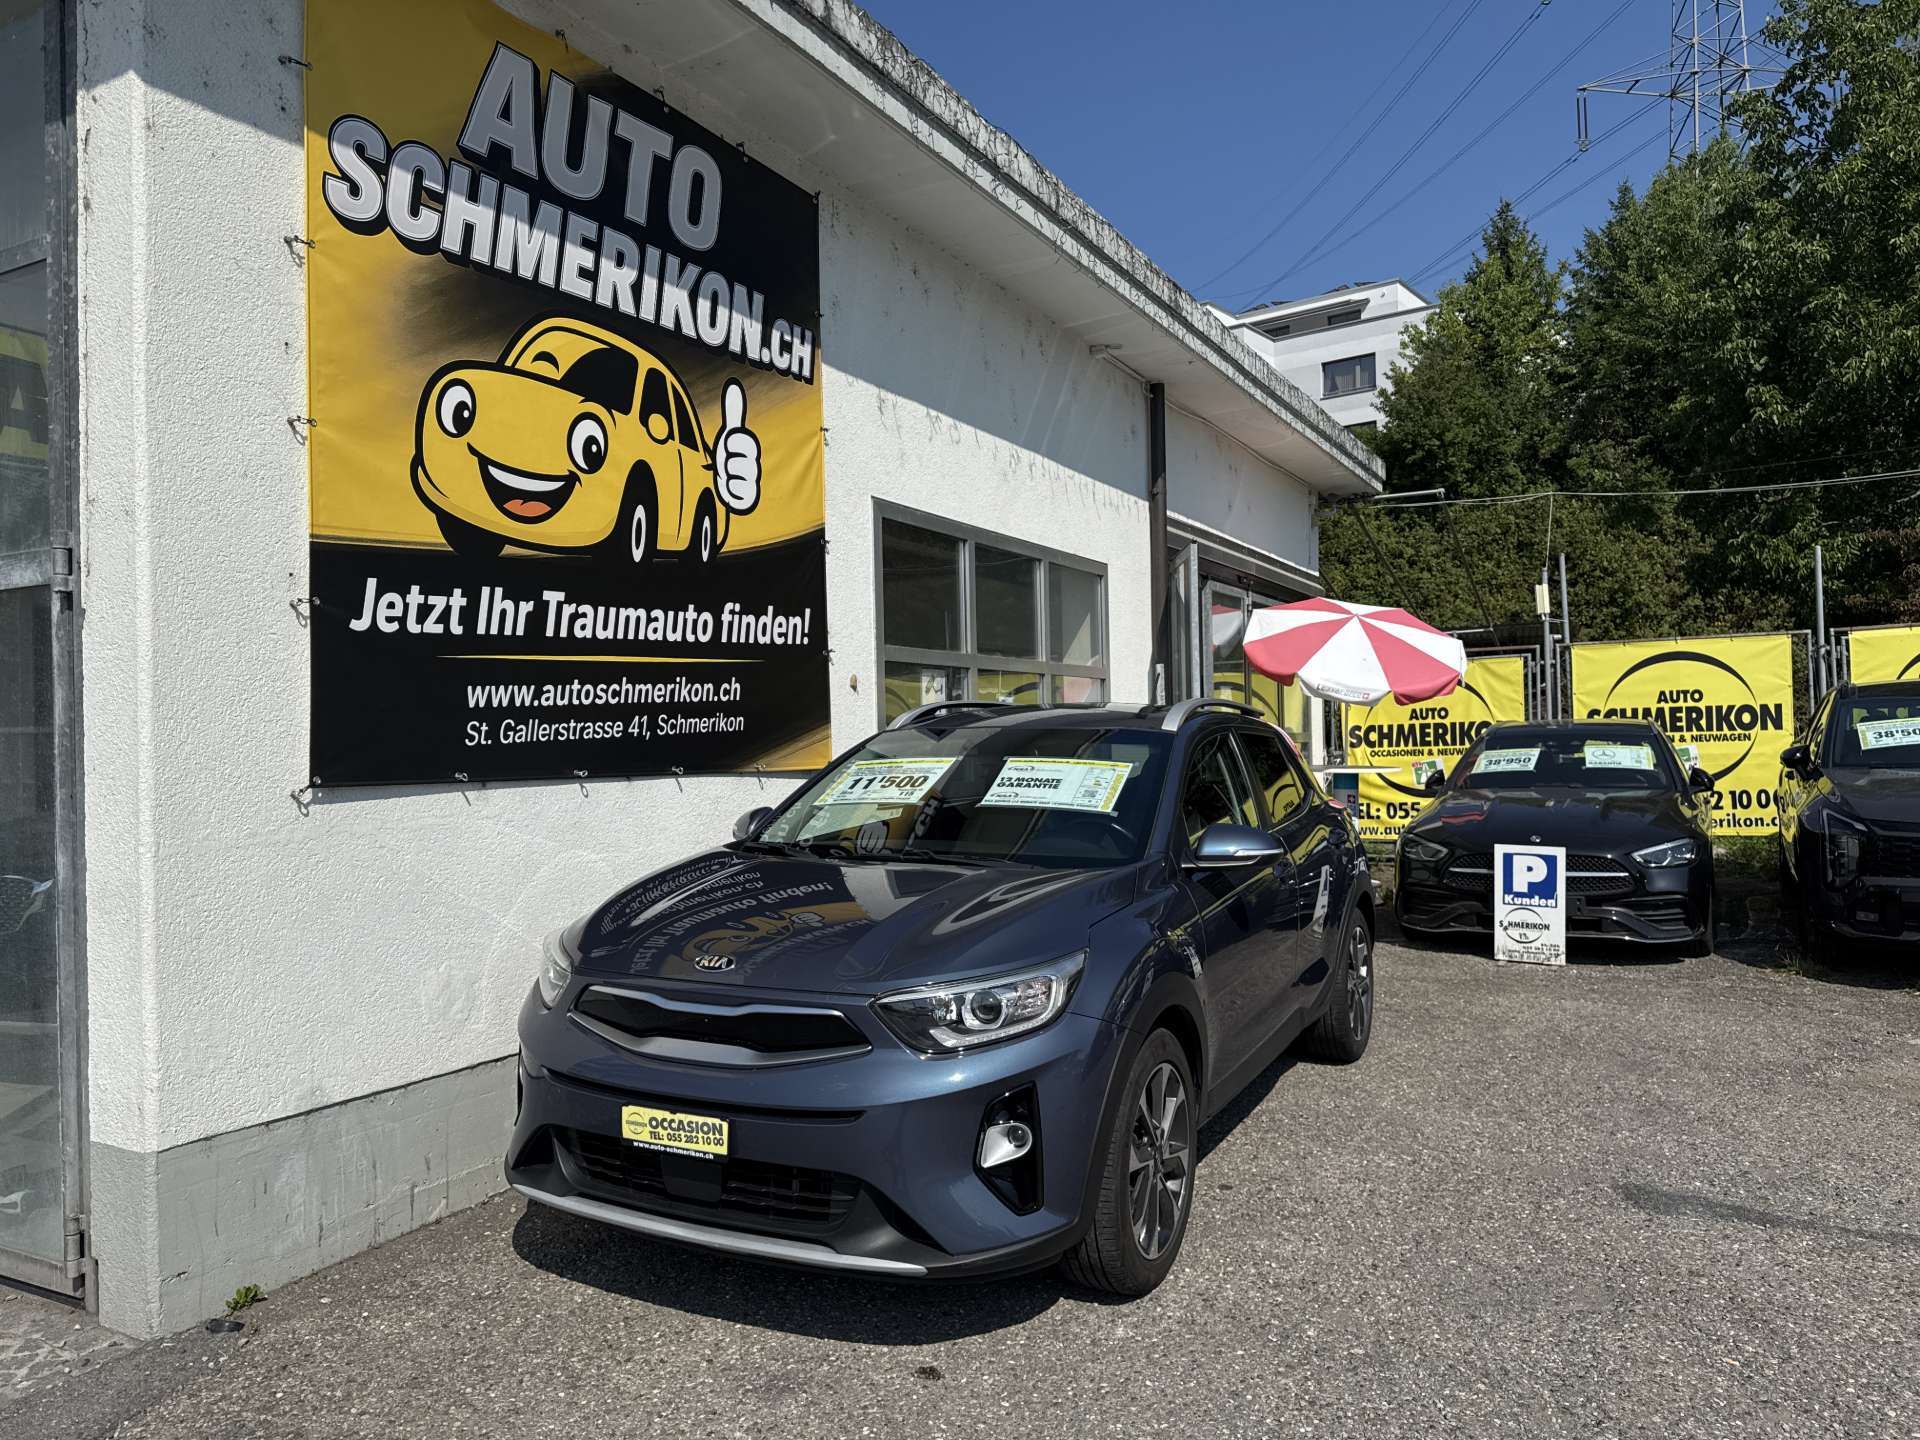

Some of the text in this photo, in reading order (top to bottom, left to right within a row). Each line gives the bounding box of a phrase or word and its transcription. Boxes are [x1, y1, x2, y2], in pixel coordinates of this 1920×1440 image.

[457, 40, 723, 252] AUTO
[323, 114, 814, 382] SCHMERIKON.CH
[349, 577, 811, 645] Jetzt Ihr Traumauto finden!
[467, 676, 741, 708] www.autoschmerikon.ch
[1657, 689, 1704, 704] AUTO
[1409, 707, 1449, 721] AUTO
[464, 713, 744, 747] St. Gallerstrasse 41, Schmerikon
[1349, 720, 1493, 749] SCHMERIKO
[1679, 734, 1687, 743] &
[1691, 733, 1751, 743] NEUWAGEN
[1370, 749, 1424, 758] OCCASIONEN
[1437, 747, 1469, 756] NEUW
[848, 775, 929, 790] 11'500
[997, 782, 1061, 790] GARANTIE
[1729, 790, 1750, 809] 10
[1358, 803, 1381, 820] EL:
[1386, 801, 1421, 820] 055
[1513, 854, 1548, 893] P
[1504, 893, 1556, 907] Kunden
[1498, 920, 1550, 932] SHMERIKON
[699, 954, 728, 968] KIA
[648, 1116, 724, 1137] OCCASION
[649, 1131, 664, 1141] TEL:
[666, 1132, 681, 1142] 055
[701, 1136, 712, 1146] 10
[713, 1137, 725, 1147] 00
